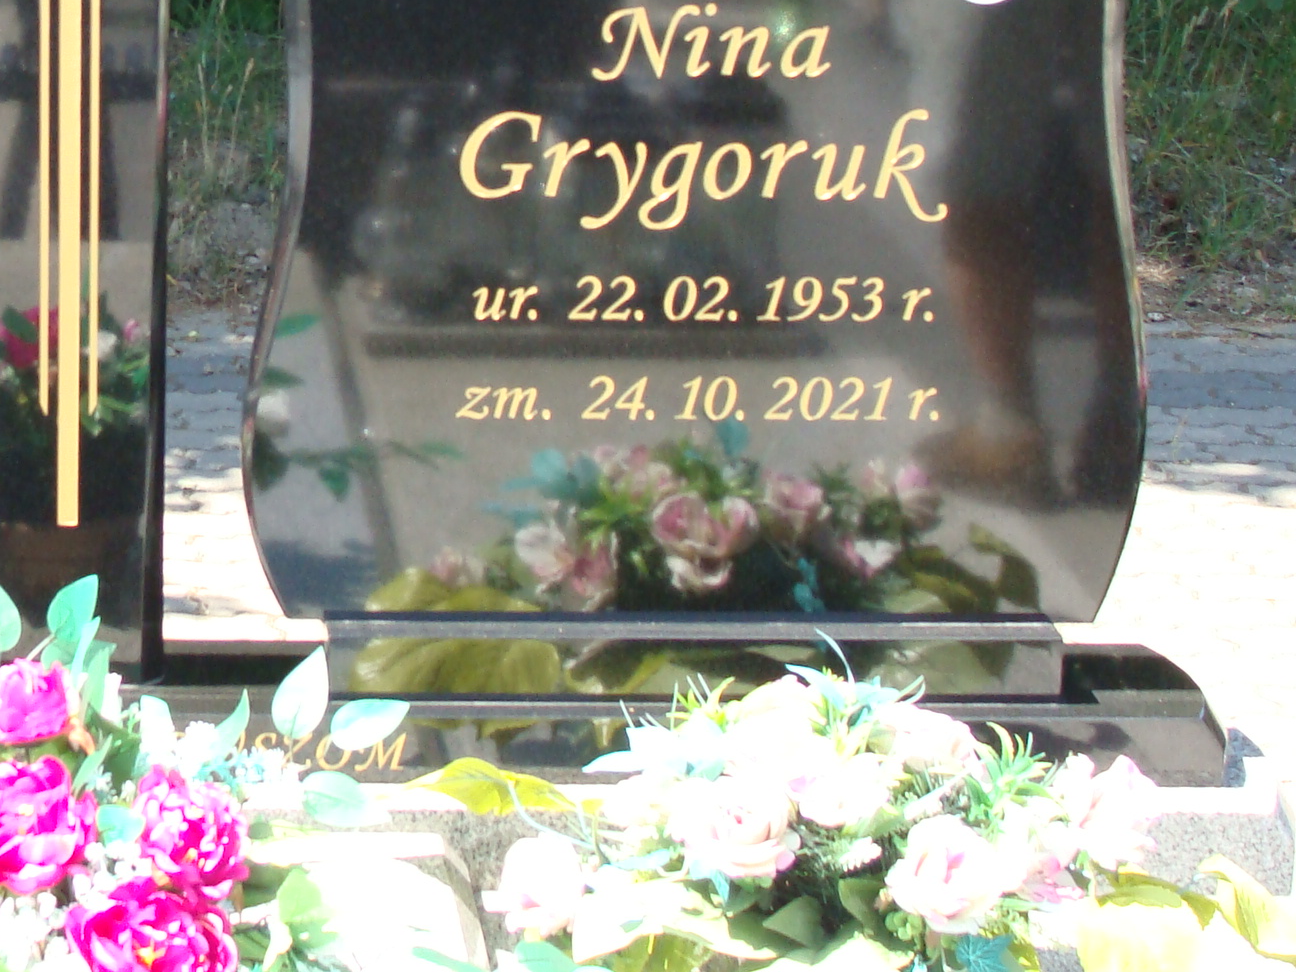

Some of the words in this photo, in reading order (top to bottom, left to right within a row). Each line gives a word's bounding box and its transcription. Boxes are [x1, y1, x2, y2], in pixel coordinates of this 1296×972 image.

[591, 3, 832, 82] Nina
[459, 108, 950, 232] Grygoruk
[472, 285, 539, 322] ur.
[568, 274, 646, 322] 22.
[663, 275, 739, 322] 02.
[758, 276, 886, 323] 1953
[903, 287, 936, 323] r.
[456, 386, 554, 422] zm.
[580, 374, 658, 422] 24.
[674, 375, 748, 422] 10.
[765, 376, 894, 423] 2021
[910, 387, 942, 422] r.
